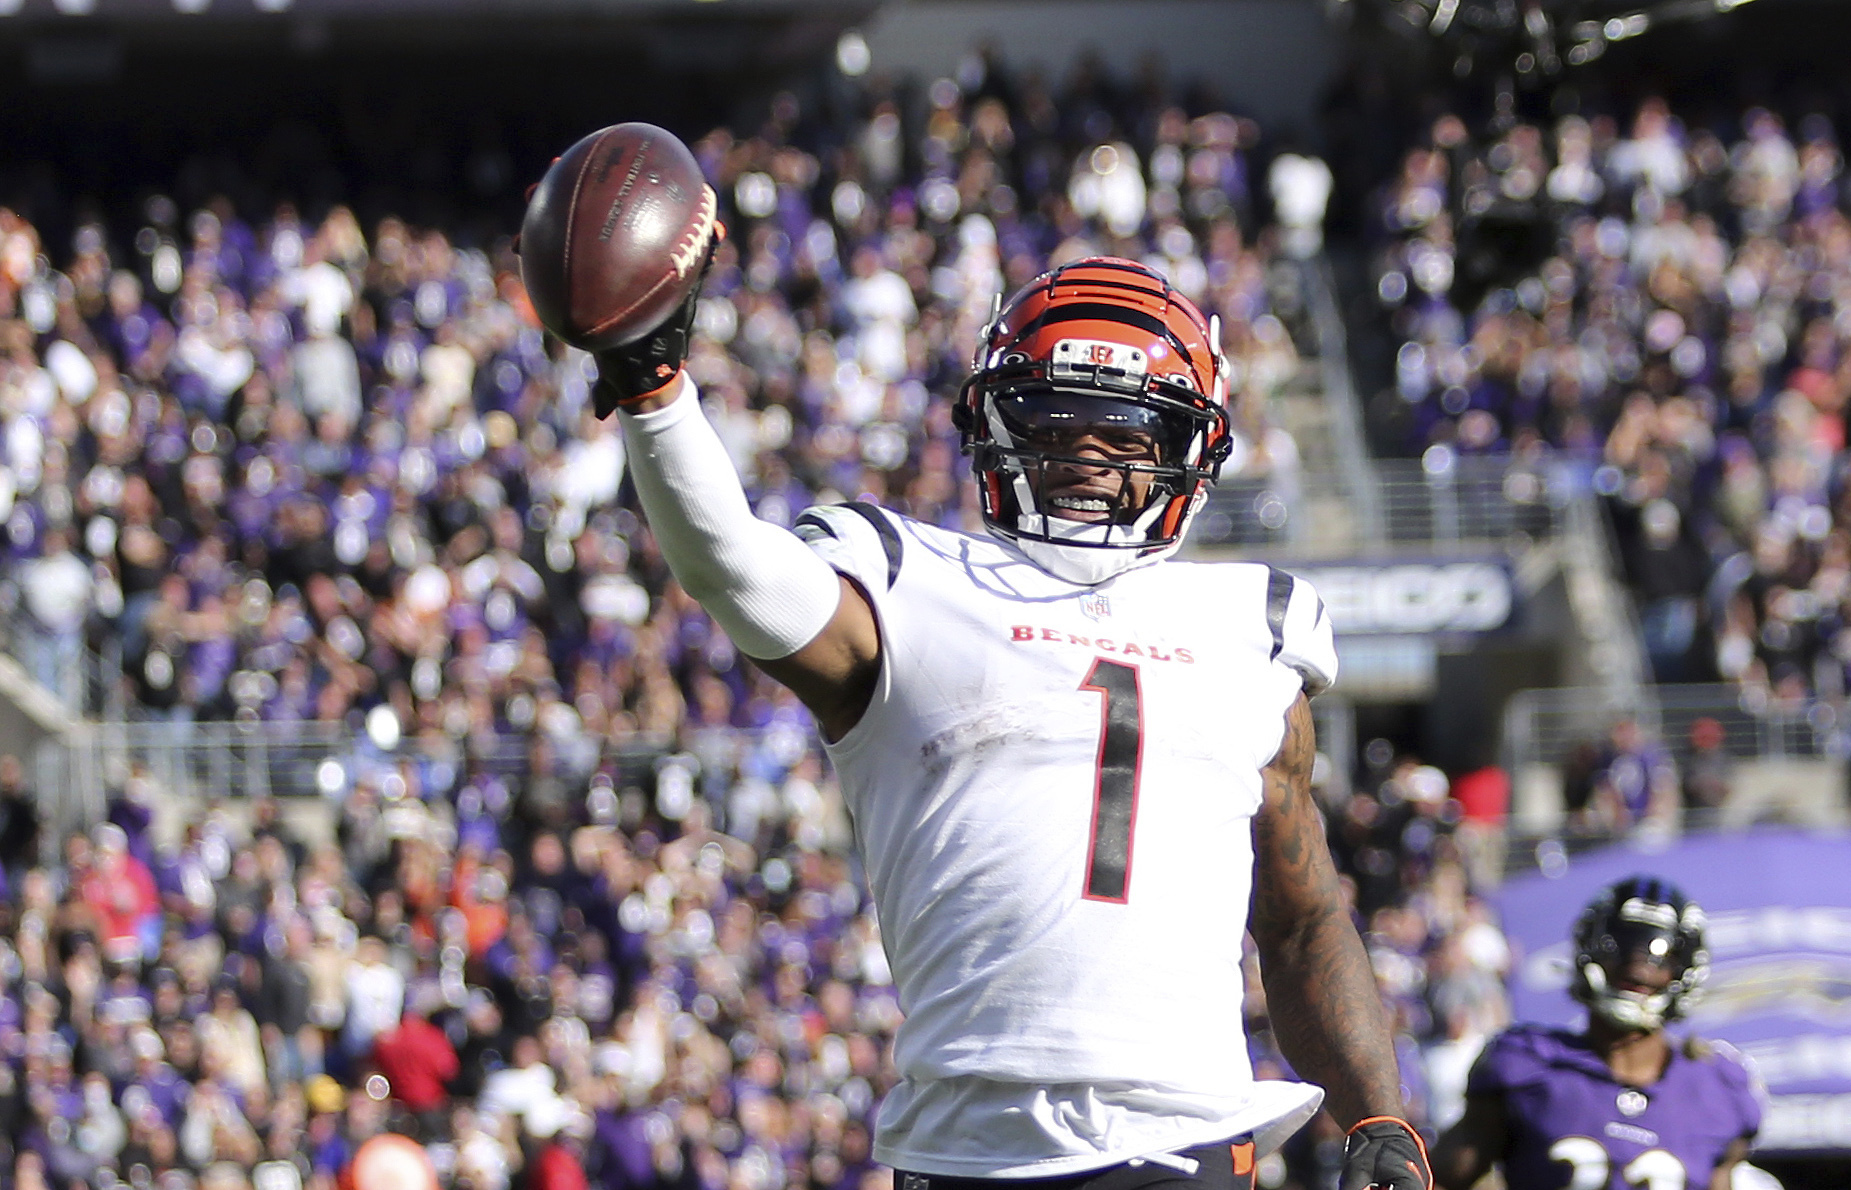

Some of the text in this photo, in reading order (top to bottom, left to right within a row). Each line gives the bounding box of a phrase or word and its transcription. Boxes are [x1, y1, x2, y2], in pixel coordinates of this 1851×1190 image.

[618, 153, 647, 197] FOOTBALL
[1010, 624, 1195, 664] BENGALS
[1077, 655, 1145, 905] 1
